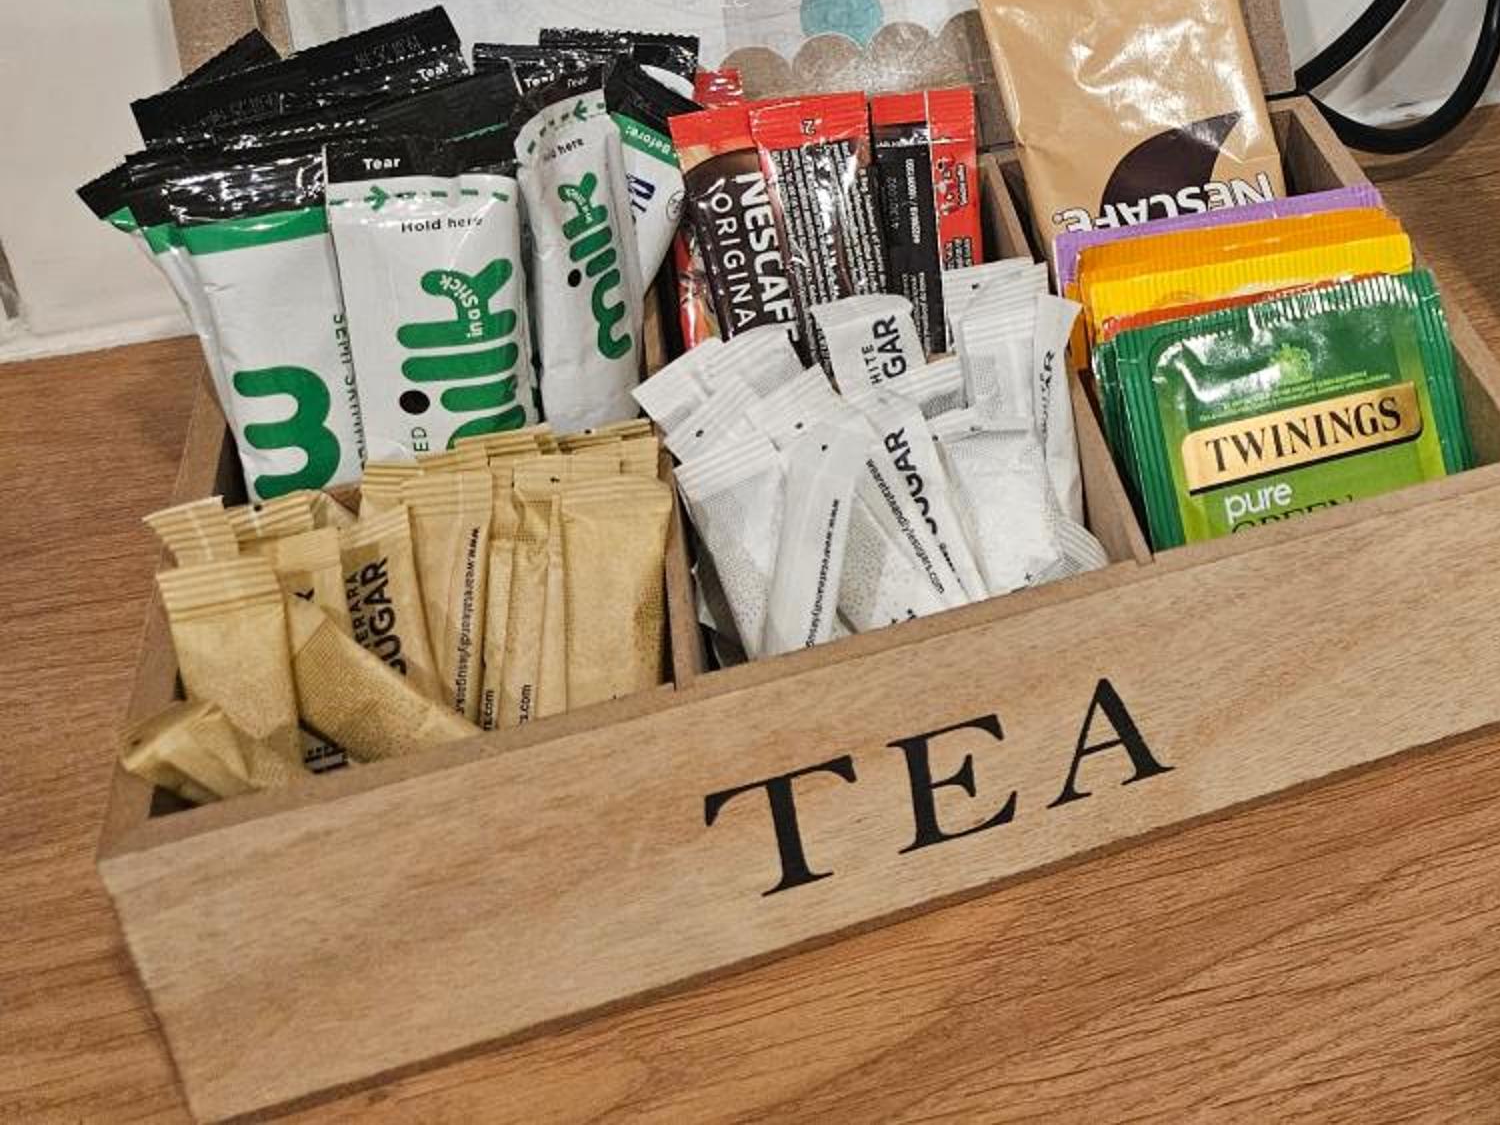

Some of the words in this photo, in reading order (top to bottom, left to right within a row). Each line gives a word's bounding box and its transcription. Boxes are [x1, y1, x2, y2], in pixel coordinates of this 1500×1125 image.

[362, 157, 402, 172] Tear
[400, 218, 442, 234] Hold
[710, 192, 758, 328] ORIGINA
[438, 273, 479, 308] Stick
[557, 172, 633, 360] milk
[396, 258, 528, 451] ilk
[860, 343, 883, 385] HITE
[871, 314, 907, 379] GAR
[1204, 395, 1402, 473] TWININGS
[1223, 481, 1293, 526] pure
[344, 571, 370, 647] ERARA
[704, 676, 1177, 898] TEA
